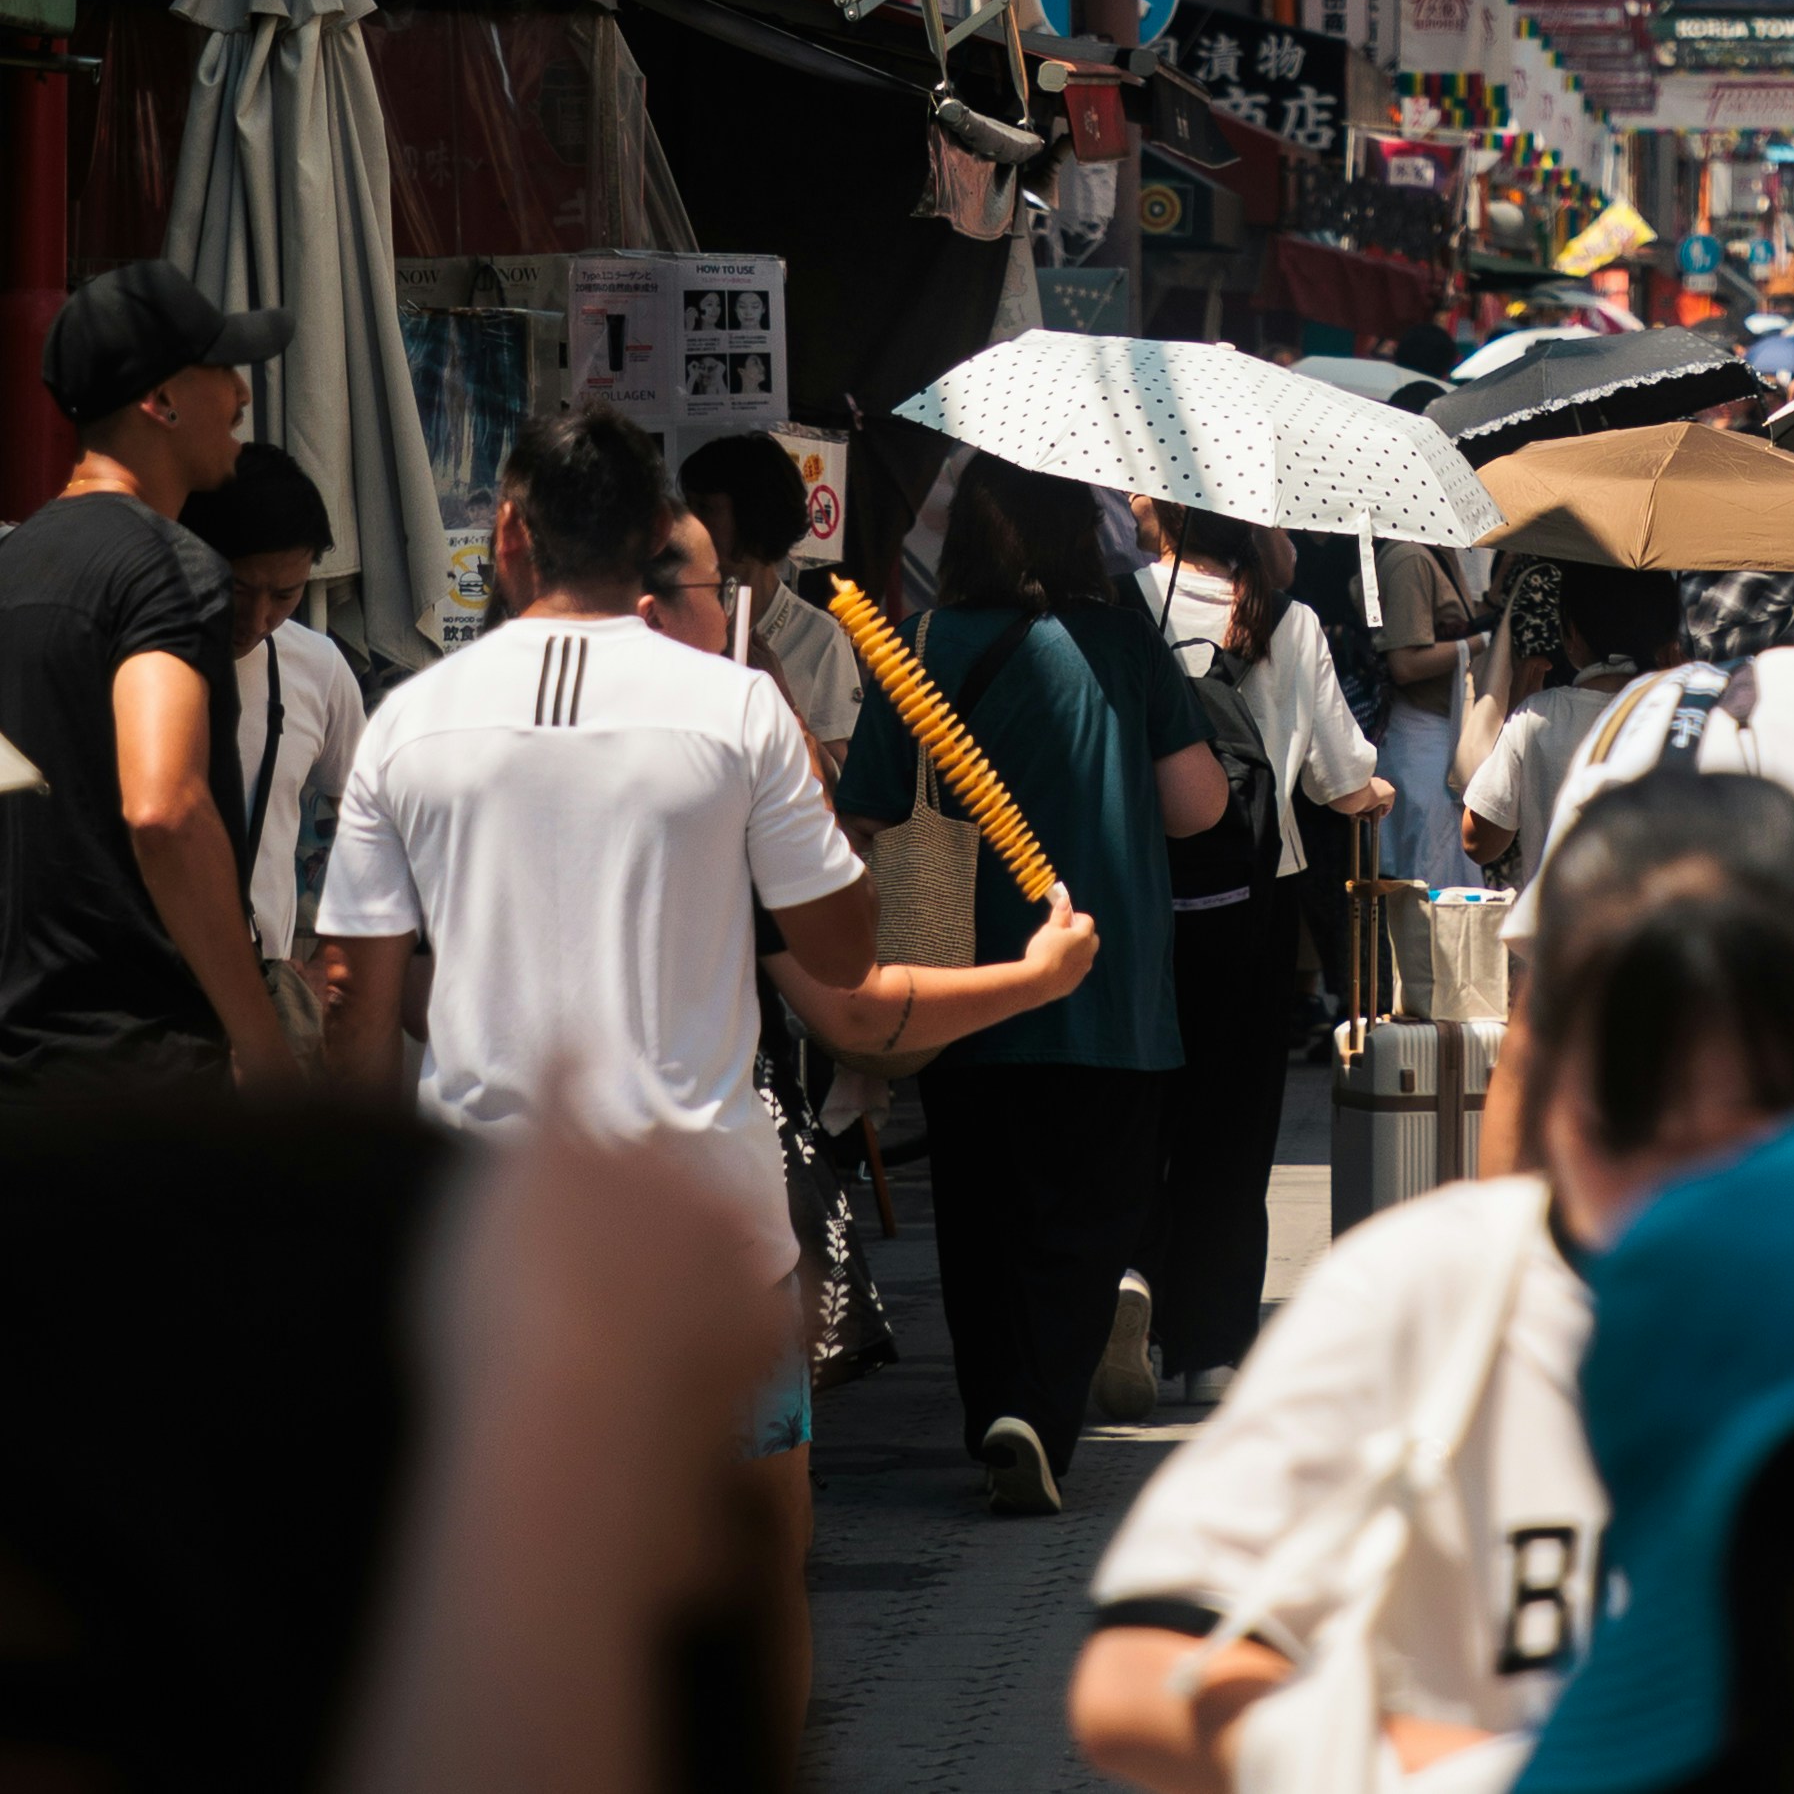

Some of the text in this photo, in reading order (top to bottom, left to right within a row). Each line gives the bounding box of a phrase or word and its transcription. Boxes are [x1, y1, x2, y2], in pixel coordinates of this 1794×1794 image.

[696, 265, 755, 275] HOW TO USE
